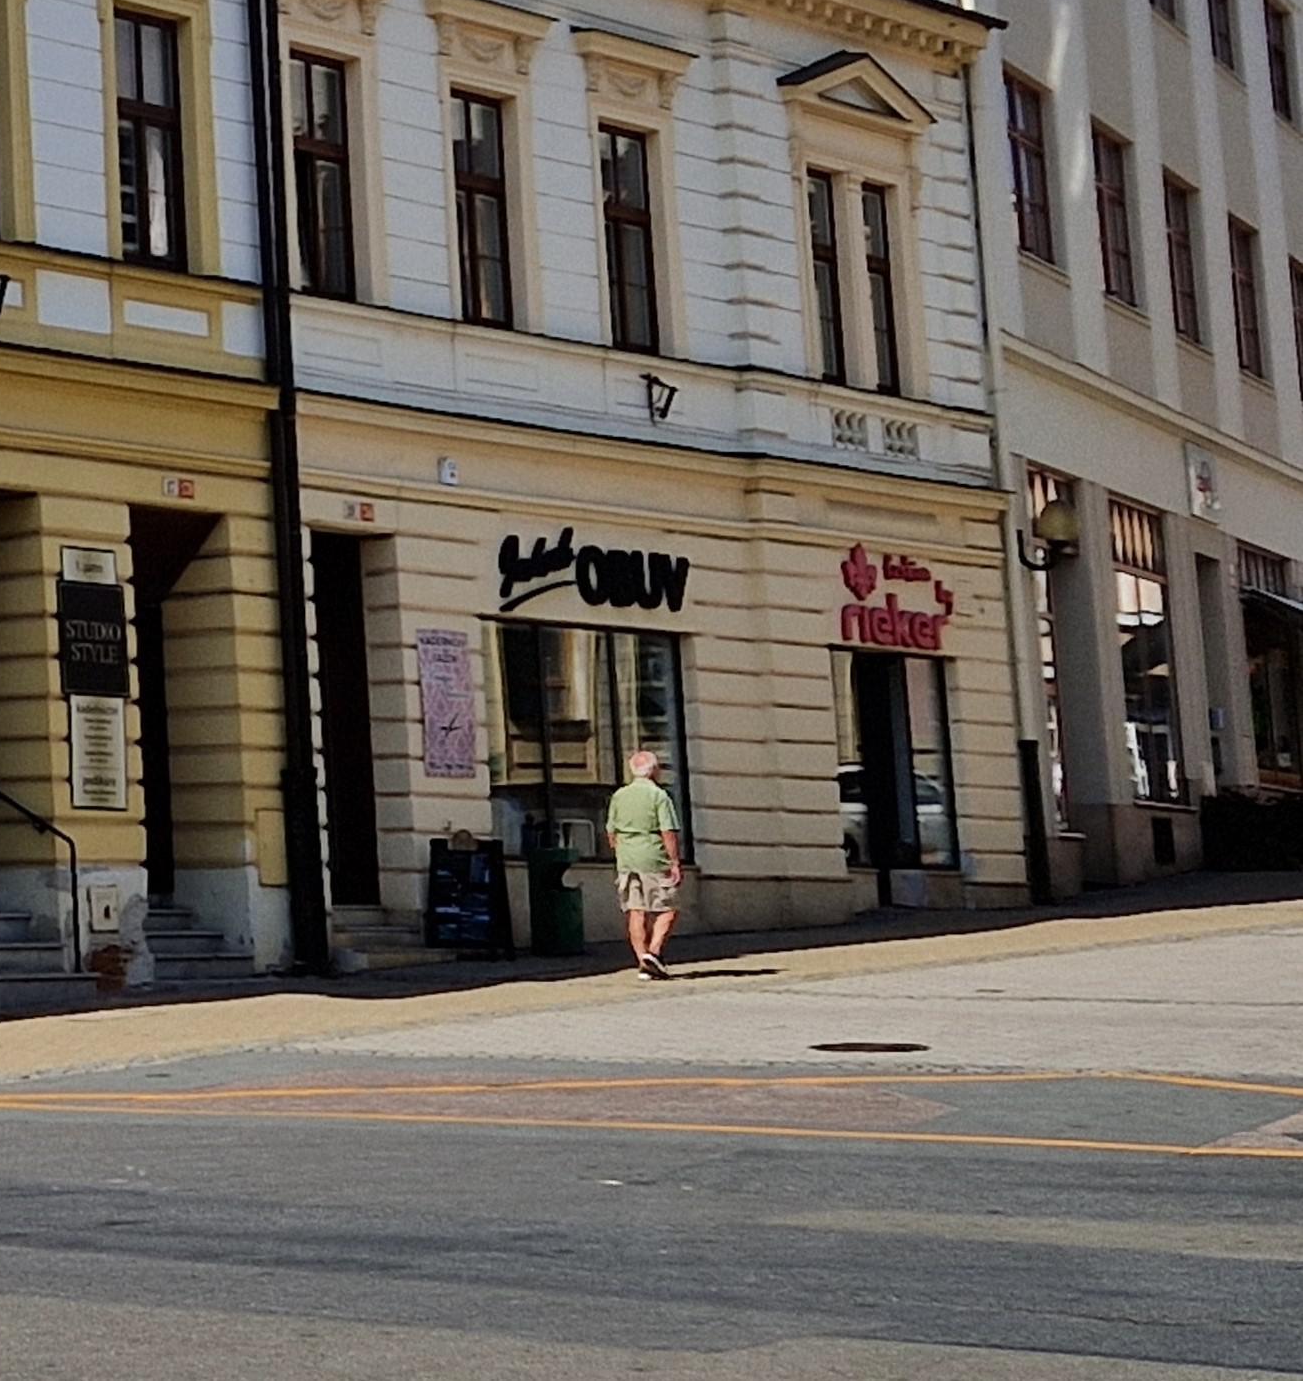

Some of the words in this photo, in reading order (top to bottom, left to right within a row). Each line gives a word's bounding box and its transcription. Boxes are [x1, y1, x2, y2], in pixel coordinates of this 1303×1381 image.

[576, 545, 691, 612] OBUV
[65, 620, 121, 641] STUDIO
[841, 592, 950, 650] rieker
[71, 642, 119, 664] STYLE
